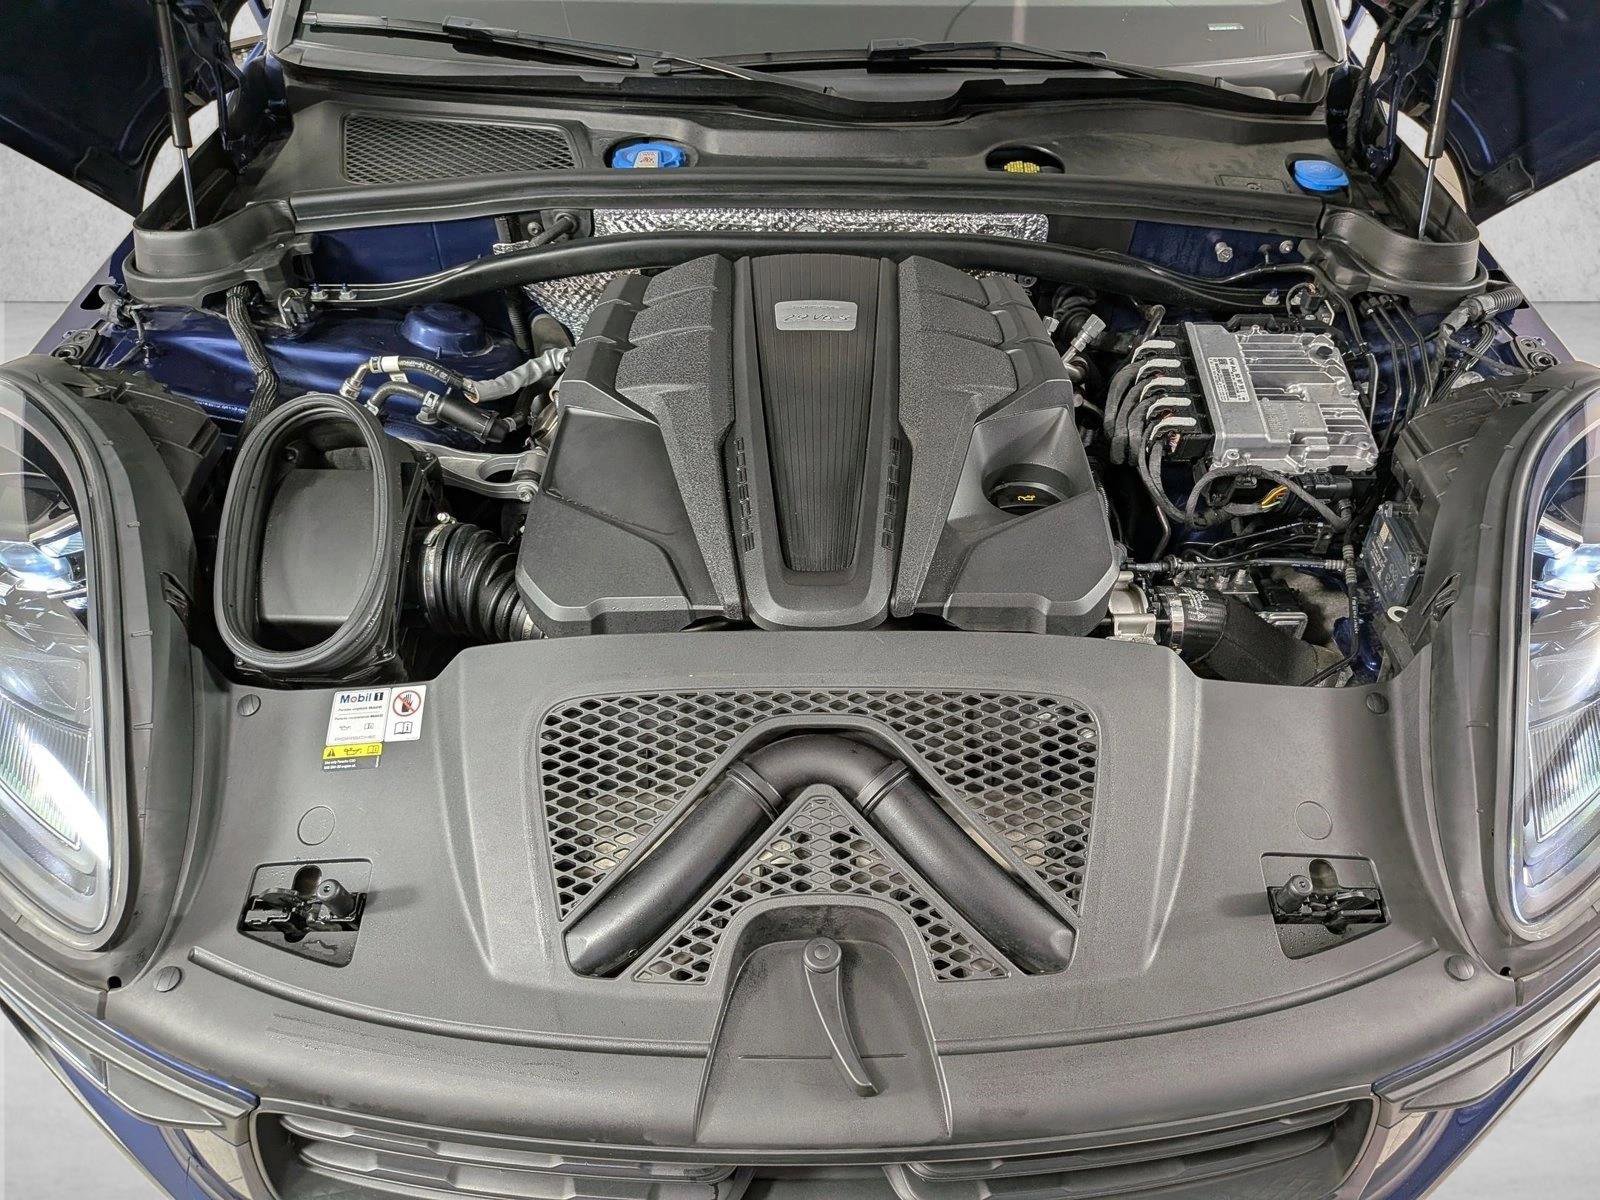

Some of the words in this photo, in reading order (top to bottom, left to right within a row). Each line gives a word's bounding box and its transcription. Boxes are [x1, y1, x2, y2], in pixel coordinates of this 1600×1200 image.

[736, 437, 755, 552] PORSCHE
[881, 436, 900, 551] PORSCHE
[340, 693, 372, 703] Mobil
